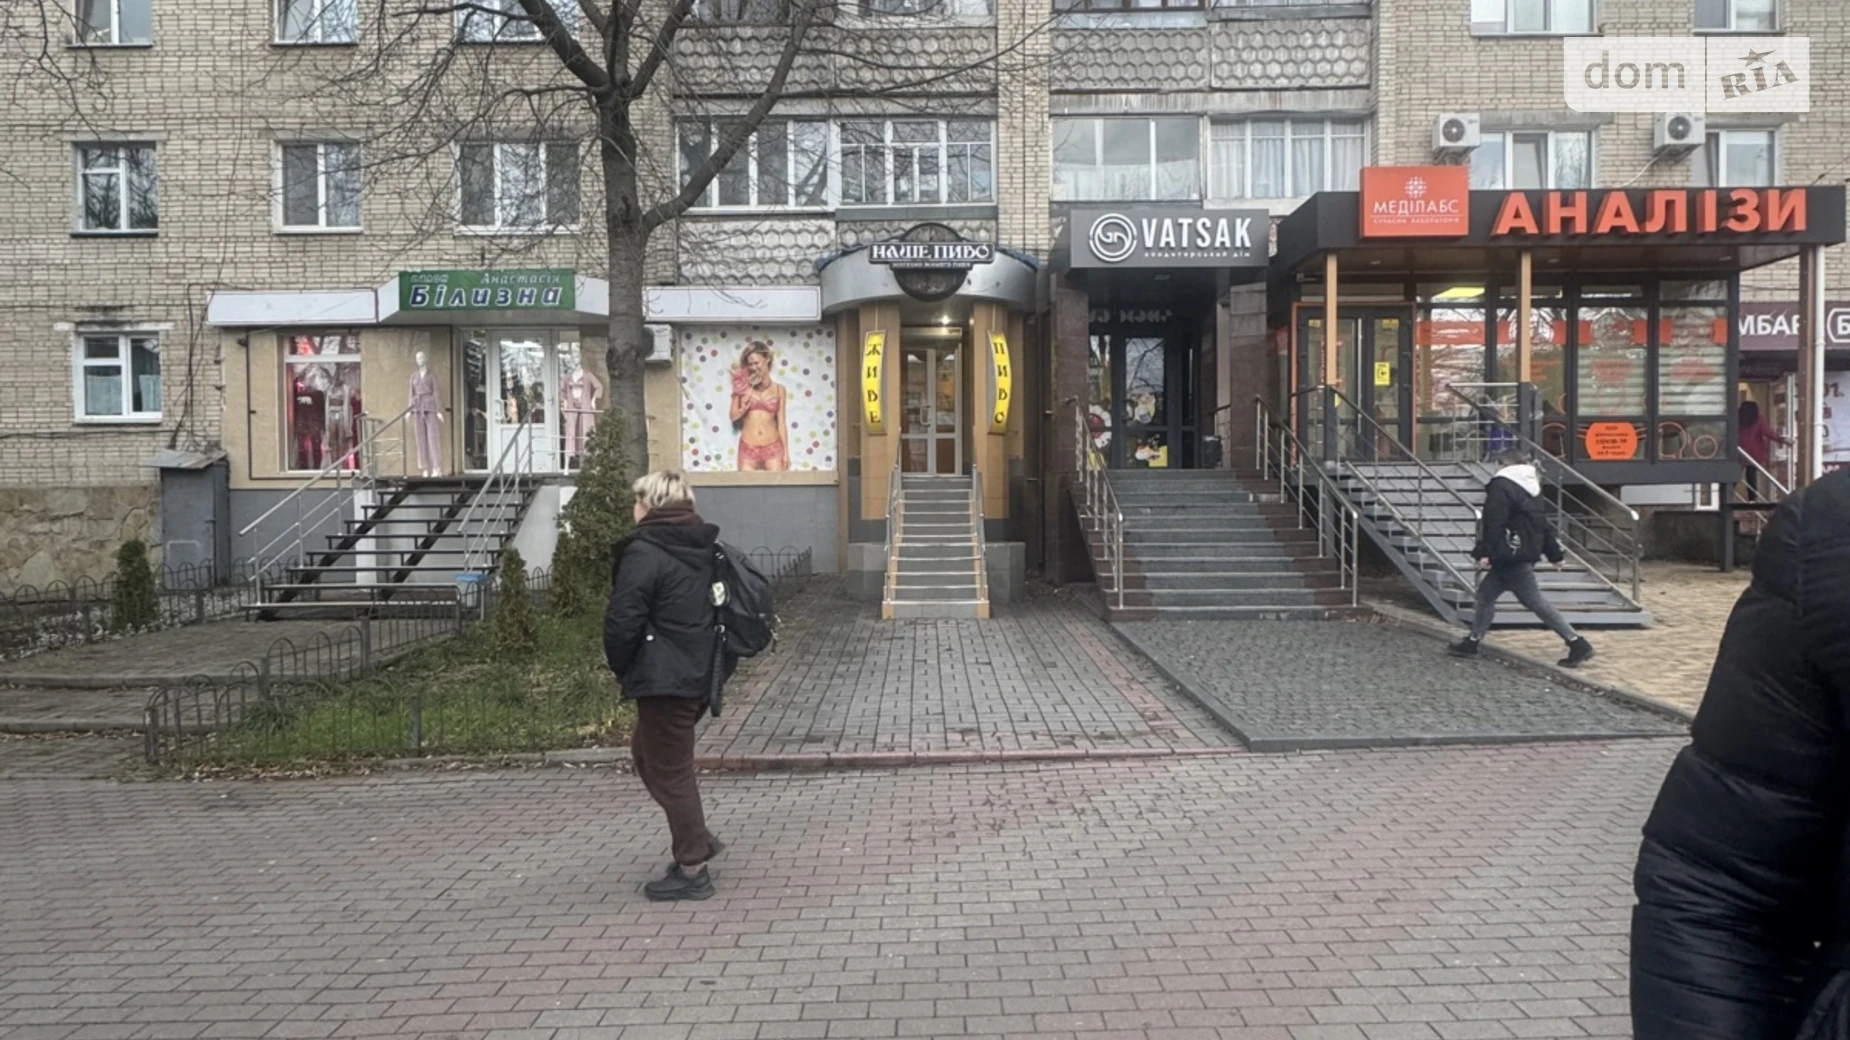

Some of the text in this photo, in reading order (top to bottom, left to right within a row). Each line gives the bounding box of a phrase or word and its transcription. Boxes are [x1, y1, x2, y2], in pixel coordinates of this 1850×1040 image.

[1373, 199, 1459, 215] МЕДІЛАБС
[1492, 188, 1807, 235] АНАЛІЗИ
[1142, 217, 1252, 248] VATSAK
[872, 243, 990, 259] НАШЕ ПИВО
[409, 284, 563, 307] Білизна
[866, 343, 882, 424] ЖИВЕ
[993, 342, 1009, 424] ПИВО
